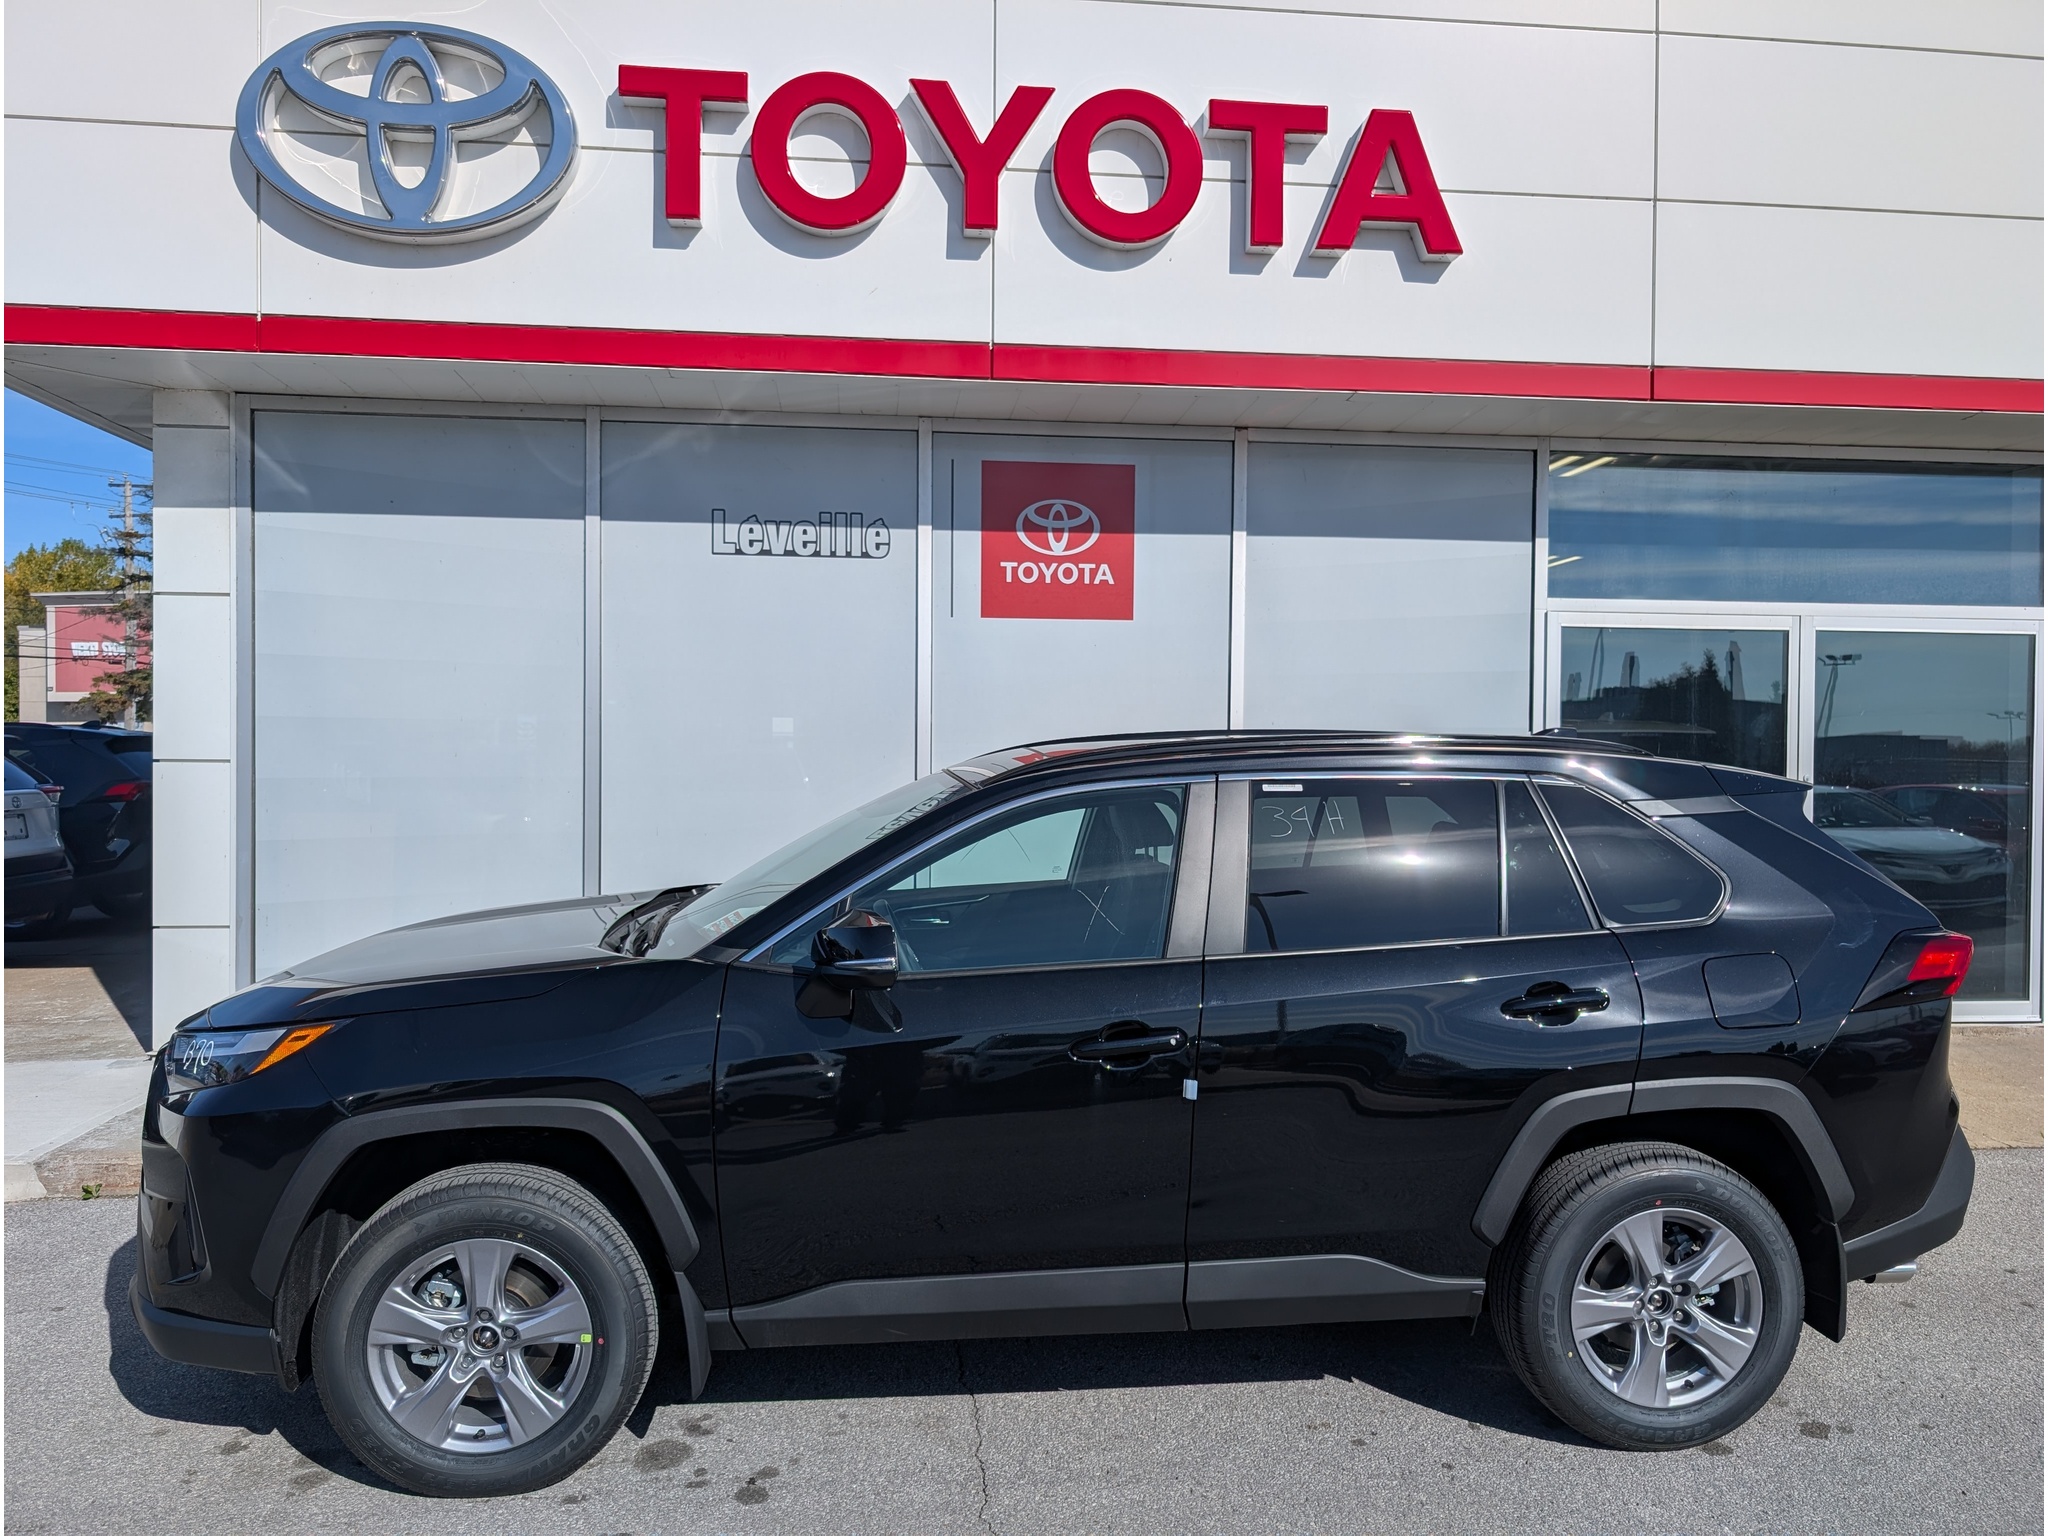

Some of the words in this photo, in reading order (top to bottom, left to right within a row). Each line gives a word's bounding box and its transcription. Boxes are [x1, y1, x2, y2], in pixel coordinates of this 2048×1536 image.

[618, 64, 1464, 260] TOYOTA
[710, 508, 891, 559] Léveillé
[1000, 561, 1115, 586] TOYOTA
[437, 1206, 557, 1232] DUNLOP
